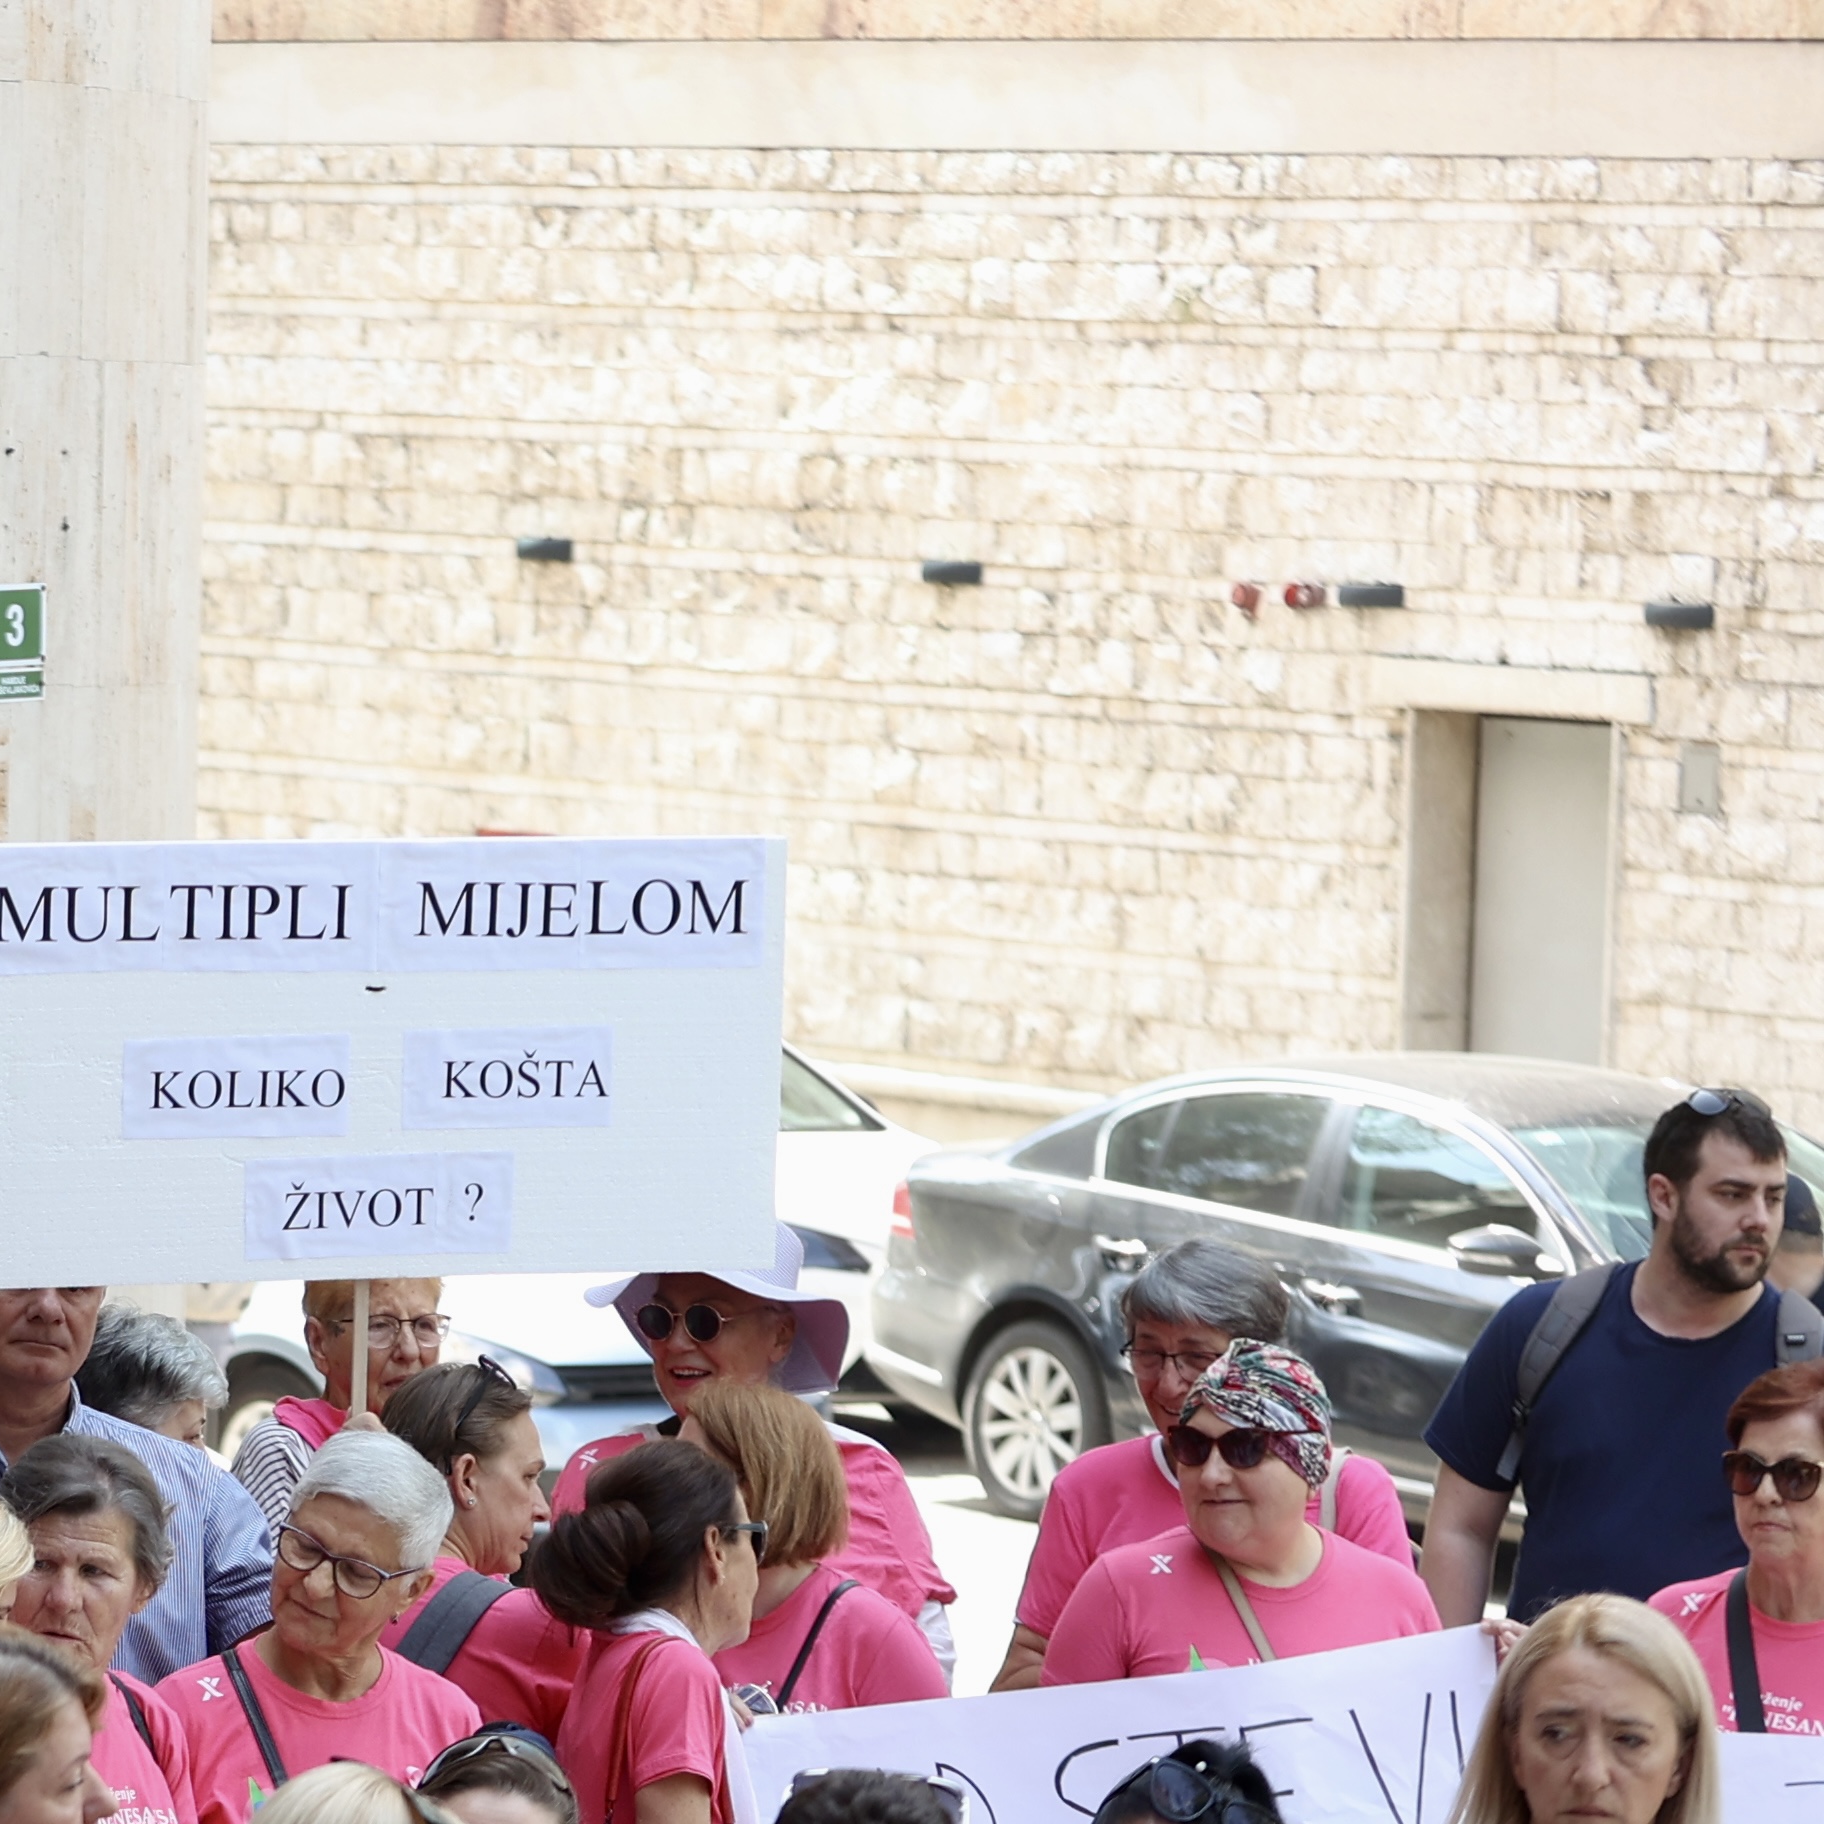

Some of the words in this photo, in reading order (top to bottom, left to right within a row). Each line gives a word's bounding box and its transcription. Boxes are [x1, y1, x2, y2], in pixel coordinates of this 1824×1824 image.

[3, 603, 25, 647] 3
[415, 877, 748, 940] MIJELOM
[149, 1067, 347, 1111] KOLIKO
[441, 1049, 610, 1101] KOŠTA
[280, 1181, 436, 1233] ŽIVOT
[462, 1181, 486, 1223] ?
